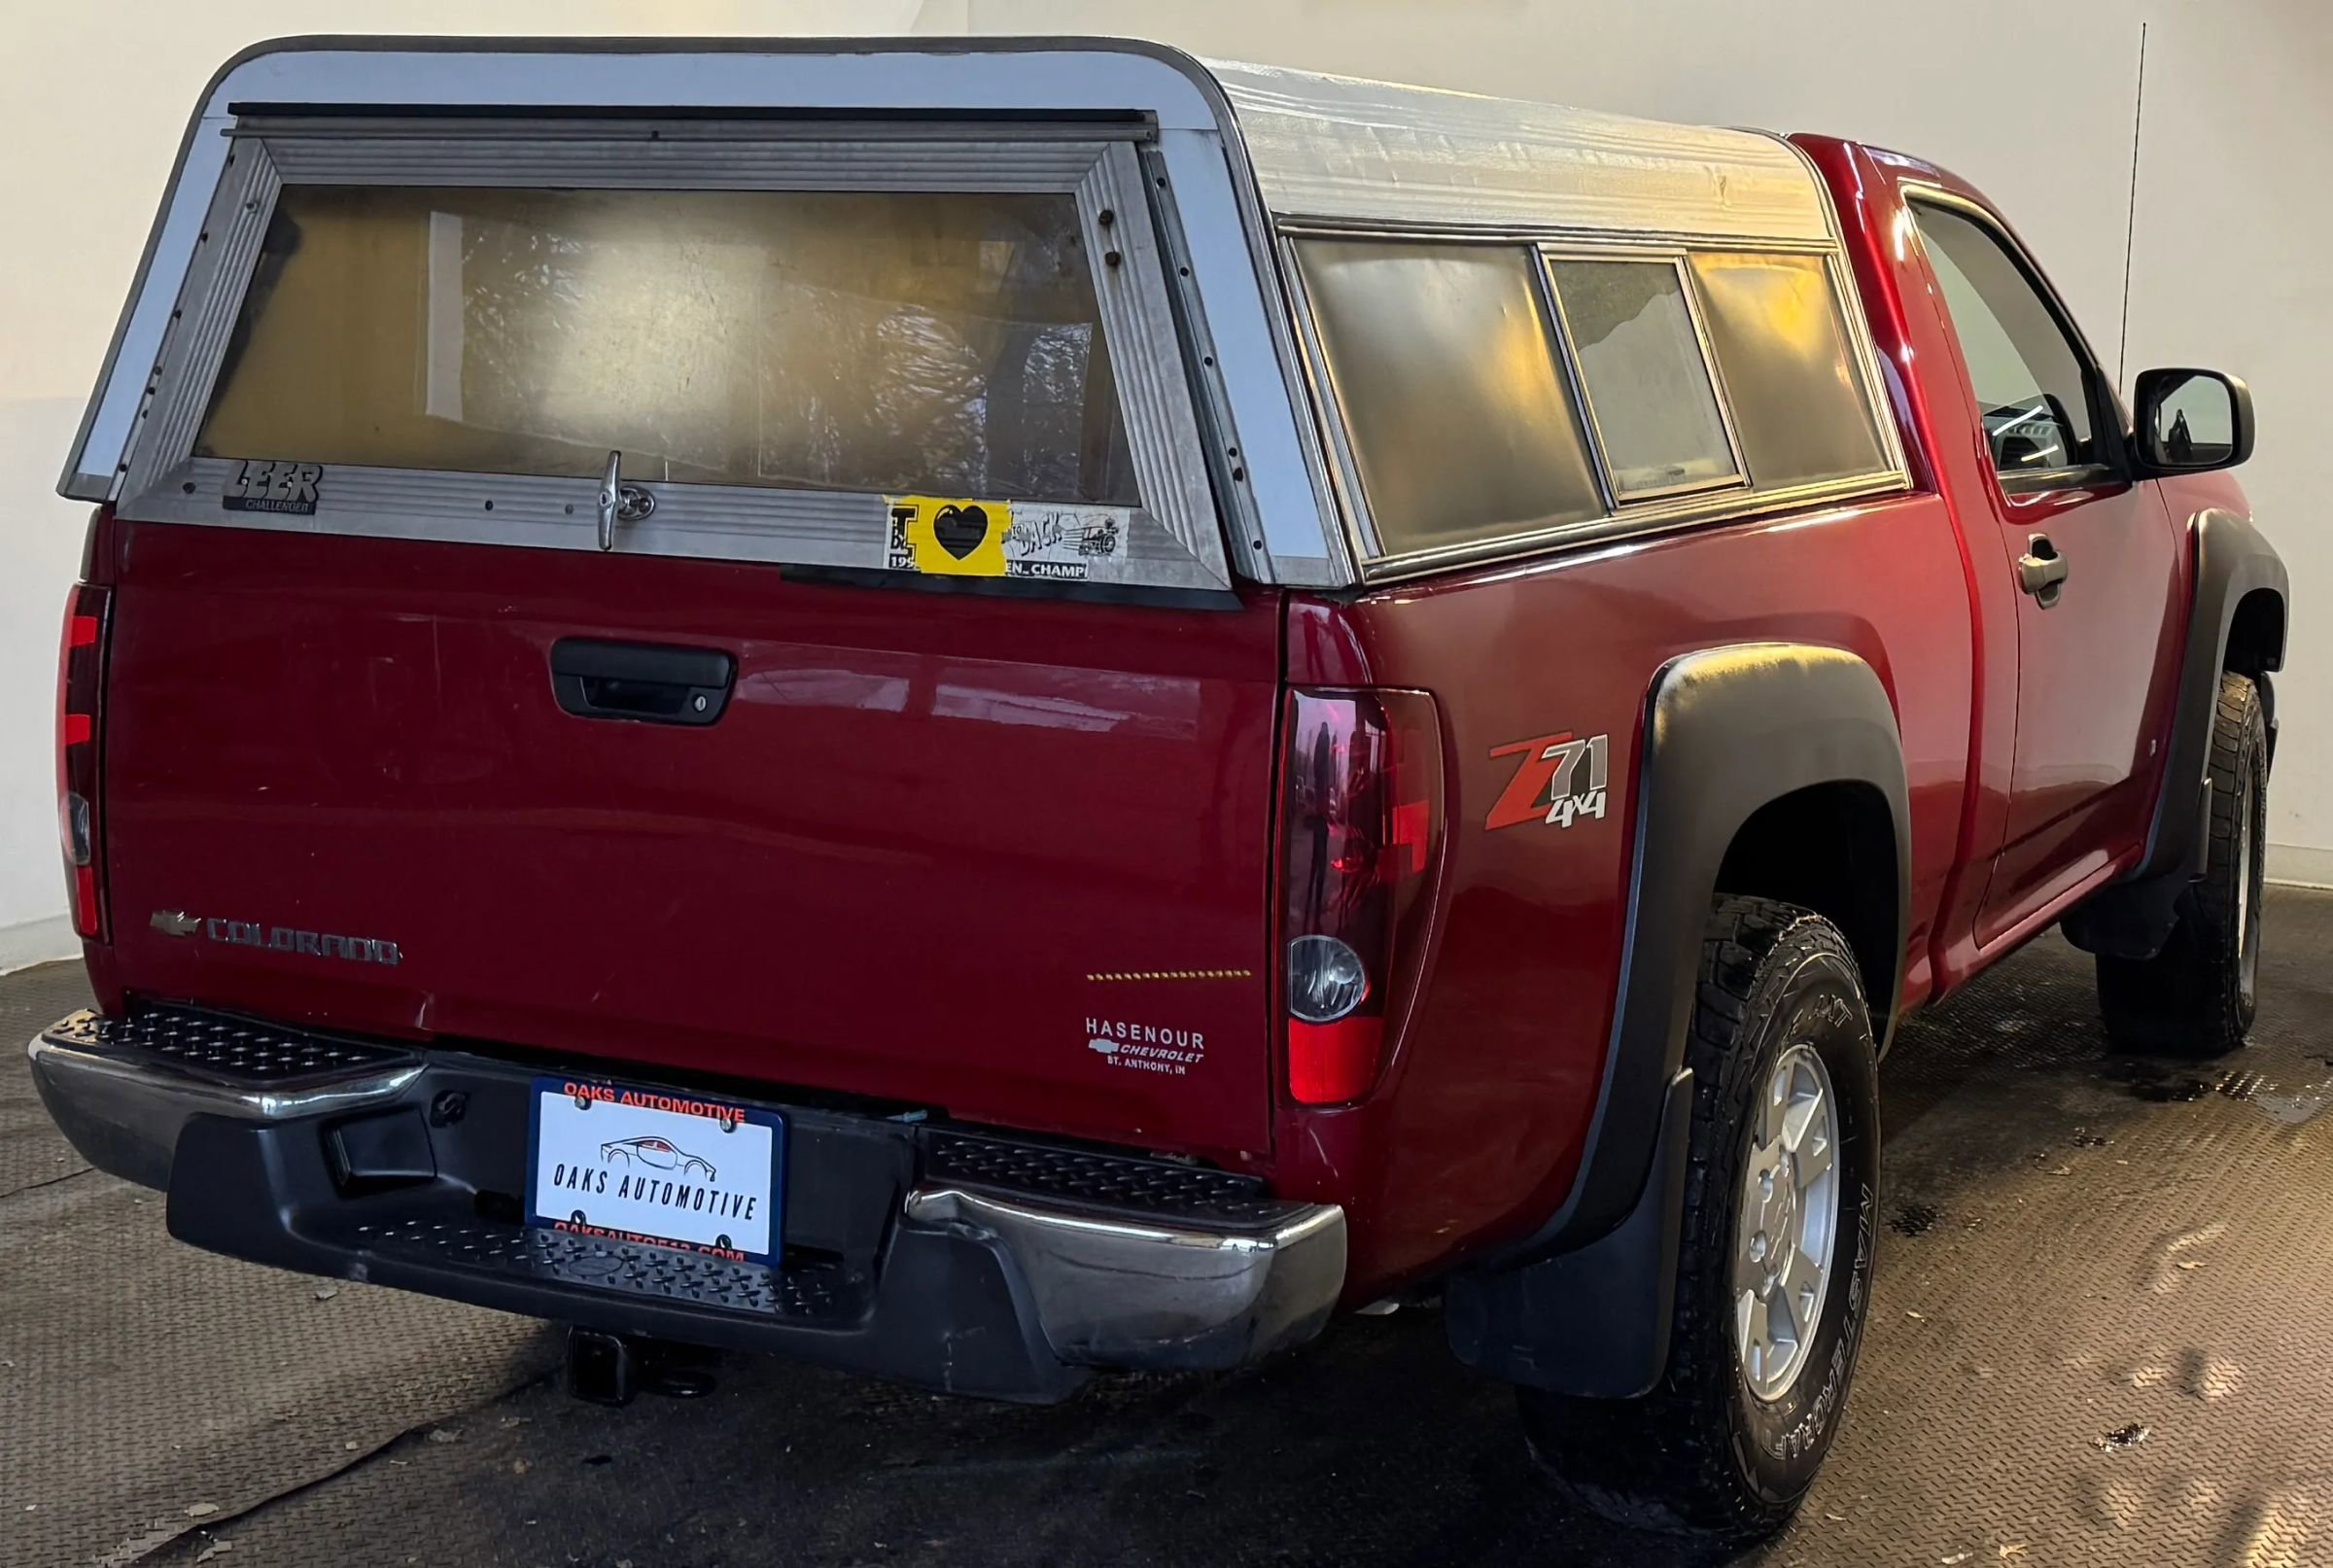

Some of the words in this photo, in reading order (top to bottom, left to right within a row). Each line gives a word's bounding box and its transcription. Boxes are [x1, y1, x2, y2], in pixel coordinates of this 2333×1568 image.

[224, 460, 323, 503] LEER
[1485, 731, 1608, 830] Z71
[207, 917, 400, 965] COLORADO
[1086, 1017, 1204, 1050] HASENOUR
[1120, 1044, 1204, 1063] CHEVROLET
[564, 1081, 615, 1101] OAKS
[620, 1091, 746, 1123] AUTOMOTIVE
[553, 1163, 609, 1195] OAKS
[618, 1174, 757, 1221] AUTOMOTIVE
